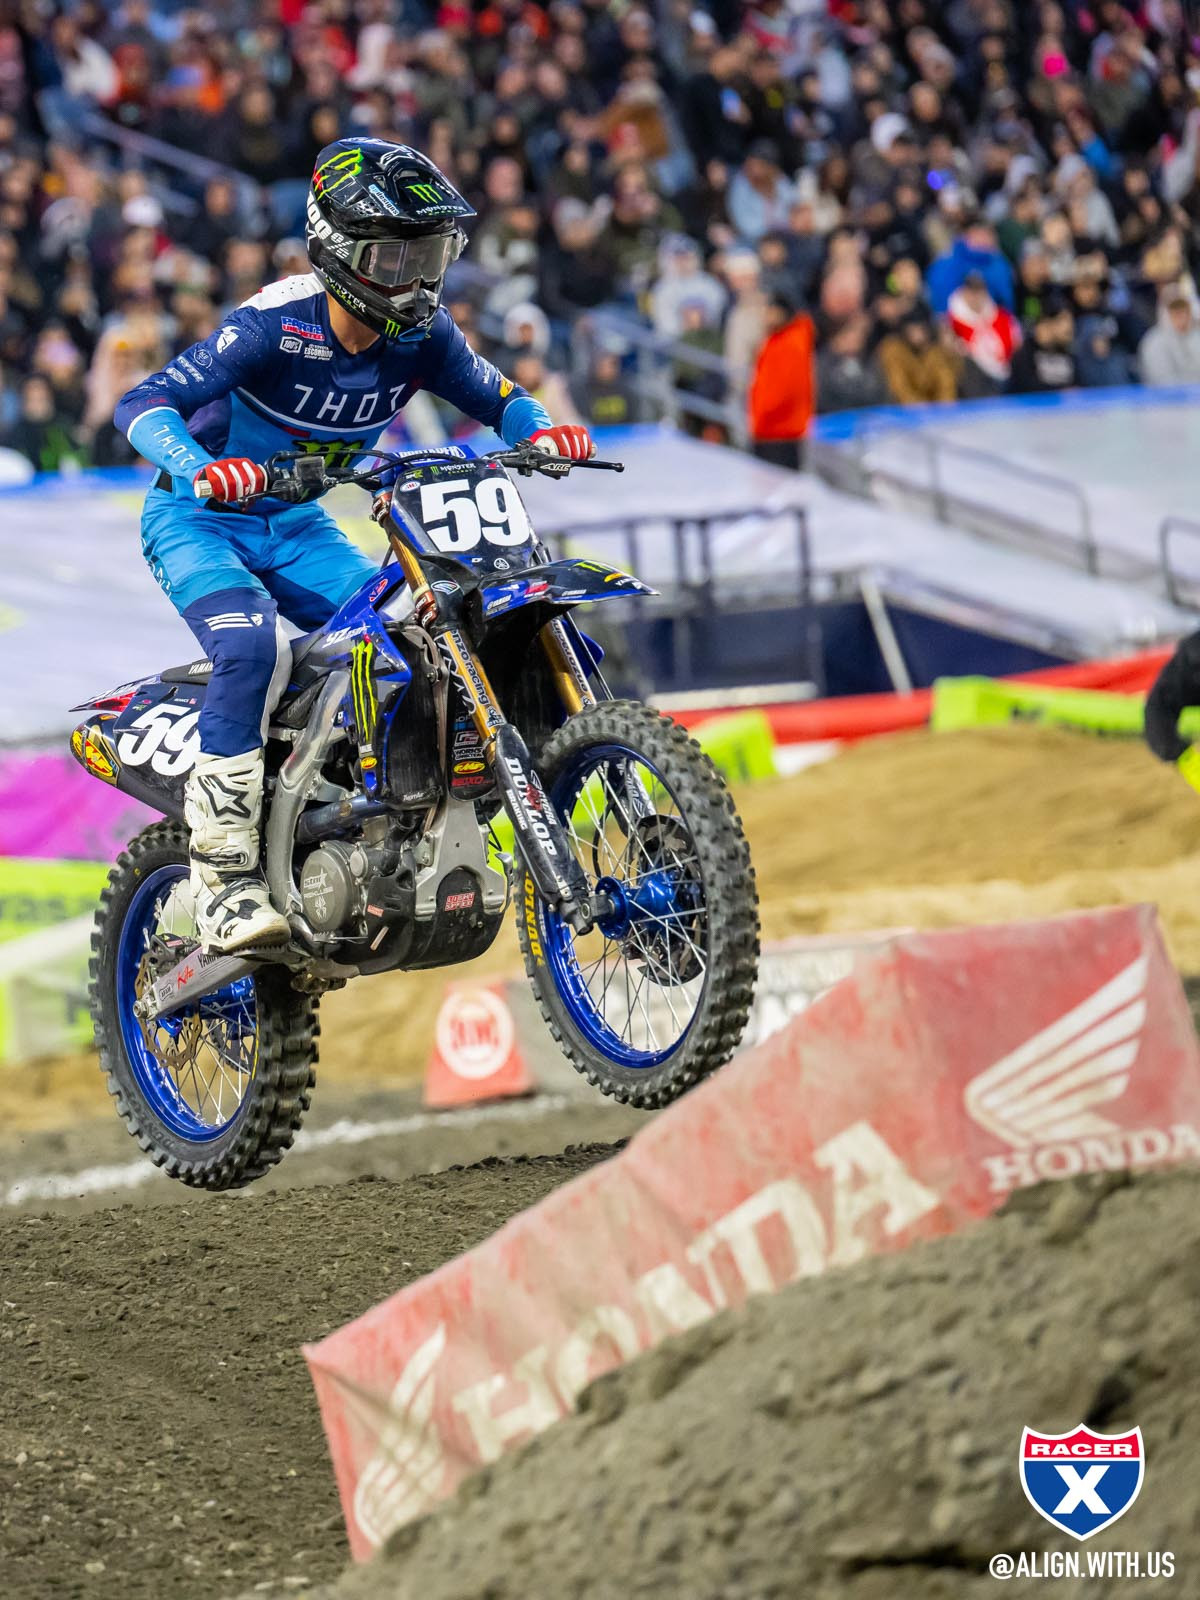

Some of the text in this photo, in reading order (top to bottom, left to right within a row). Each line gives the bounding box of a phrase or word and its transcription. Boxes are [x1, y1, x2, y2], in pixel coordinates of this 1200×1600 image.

[540, 463, 572, 472] ARC
[420, 477, 530, 552] 59
[118, 703, 201, 776] 59
[506, 788, 528, 831] BRAKING
[523, 871, 543, 958] DUNLO
[980, 1123, 1200, 1192] HONDA
